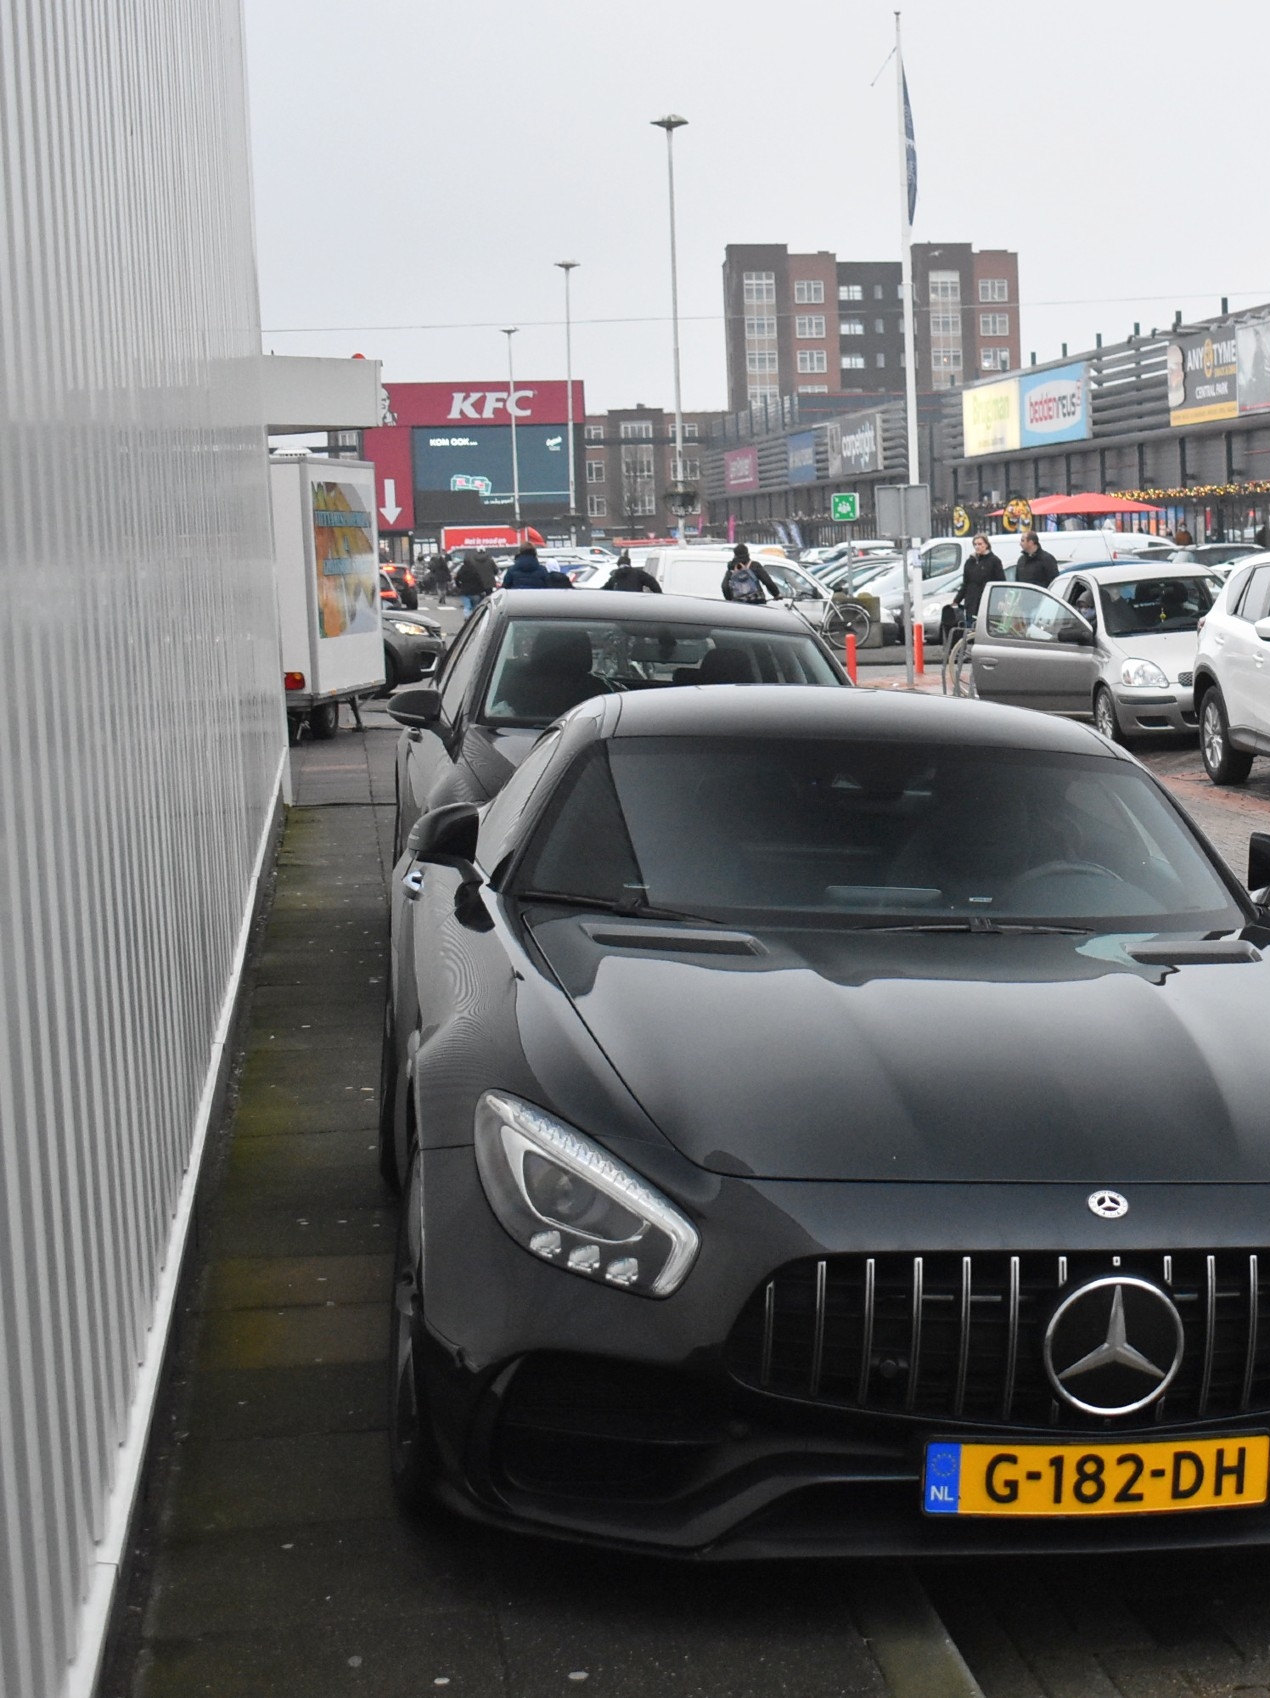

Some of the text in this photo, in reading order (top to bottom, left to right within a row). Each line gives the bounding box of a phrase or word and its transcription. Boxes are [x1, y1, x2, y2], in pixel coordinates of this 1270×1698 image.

[1187, 348, 1204, 372] ANY
[1195, 382, 1229, 400] CENTRAL PARK
[447, 390, 534, 419] KFC
[985, 1446, 1247, 1505] G-182-DH
[930, 1486, 954, 1502] NL
